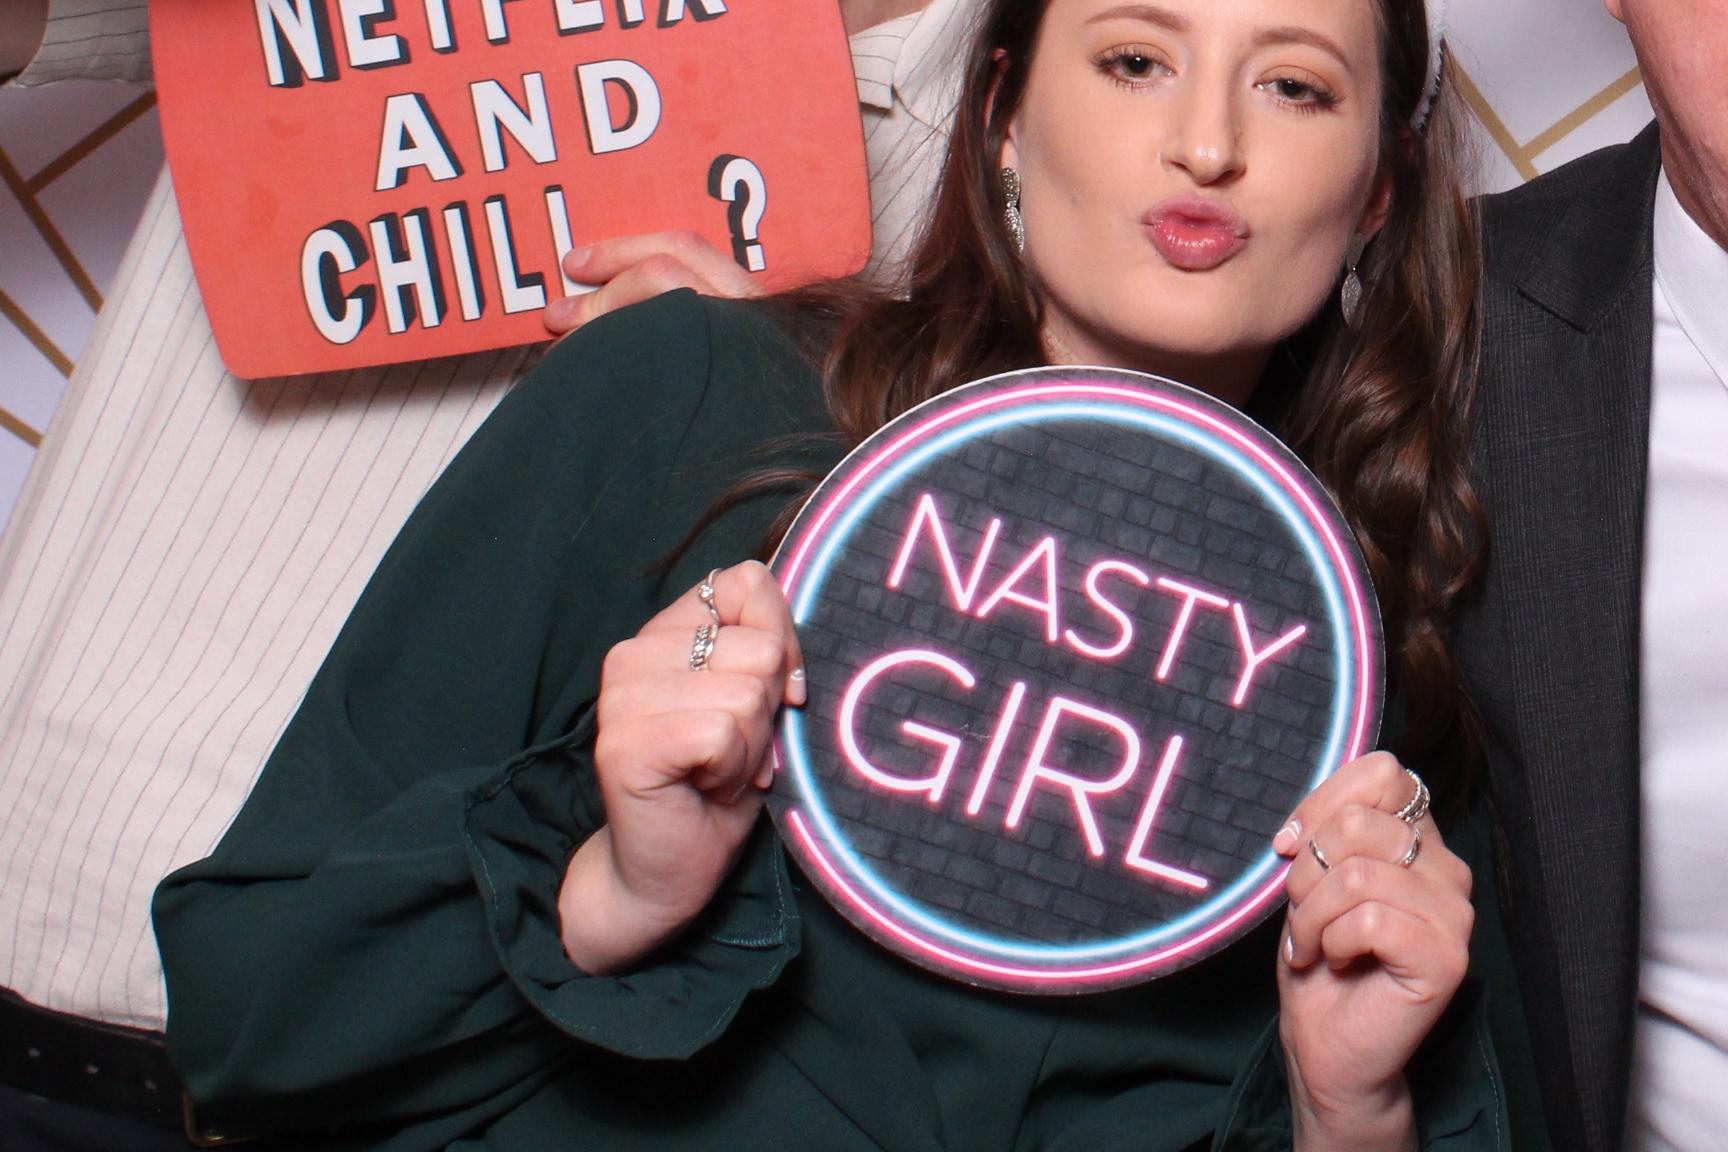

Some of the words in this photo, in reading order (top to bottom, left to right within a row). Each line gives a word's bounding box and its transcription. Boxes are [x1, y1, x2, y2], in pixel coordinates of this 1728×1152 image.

[374, 58, 662, 191] AND
[300, 185, 598, 345] CHILL
[887, 493, 1307, 705] NASTY
[839, 650, 1209, 890] GIRL
